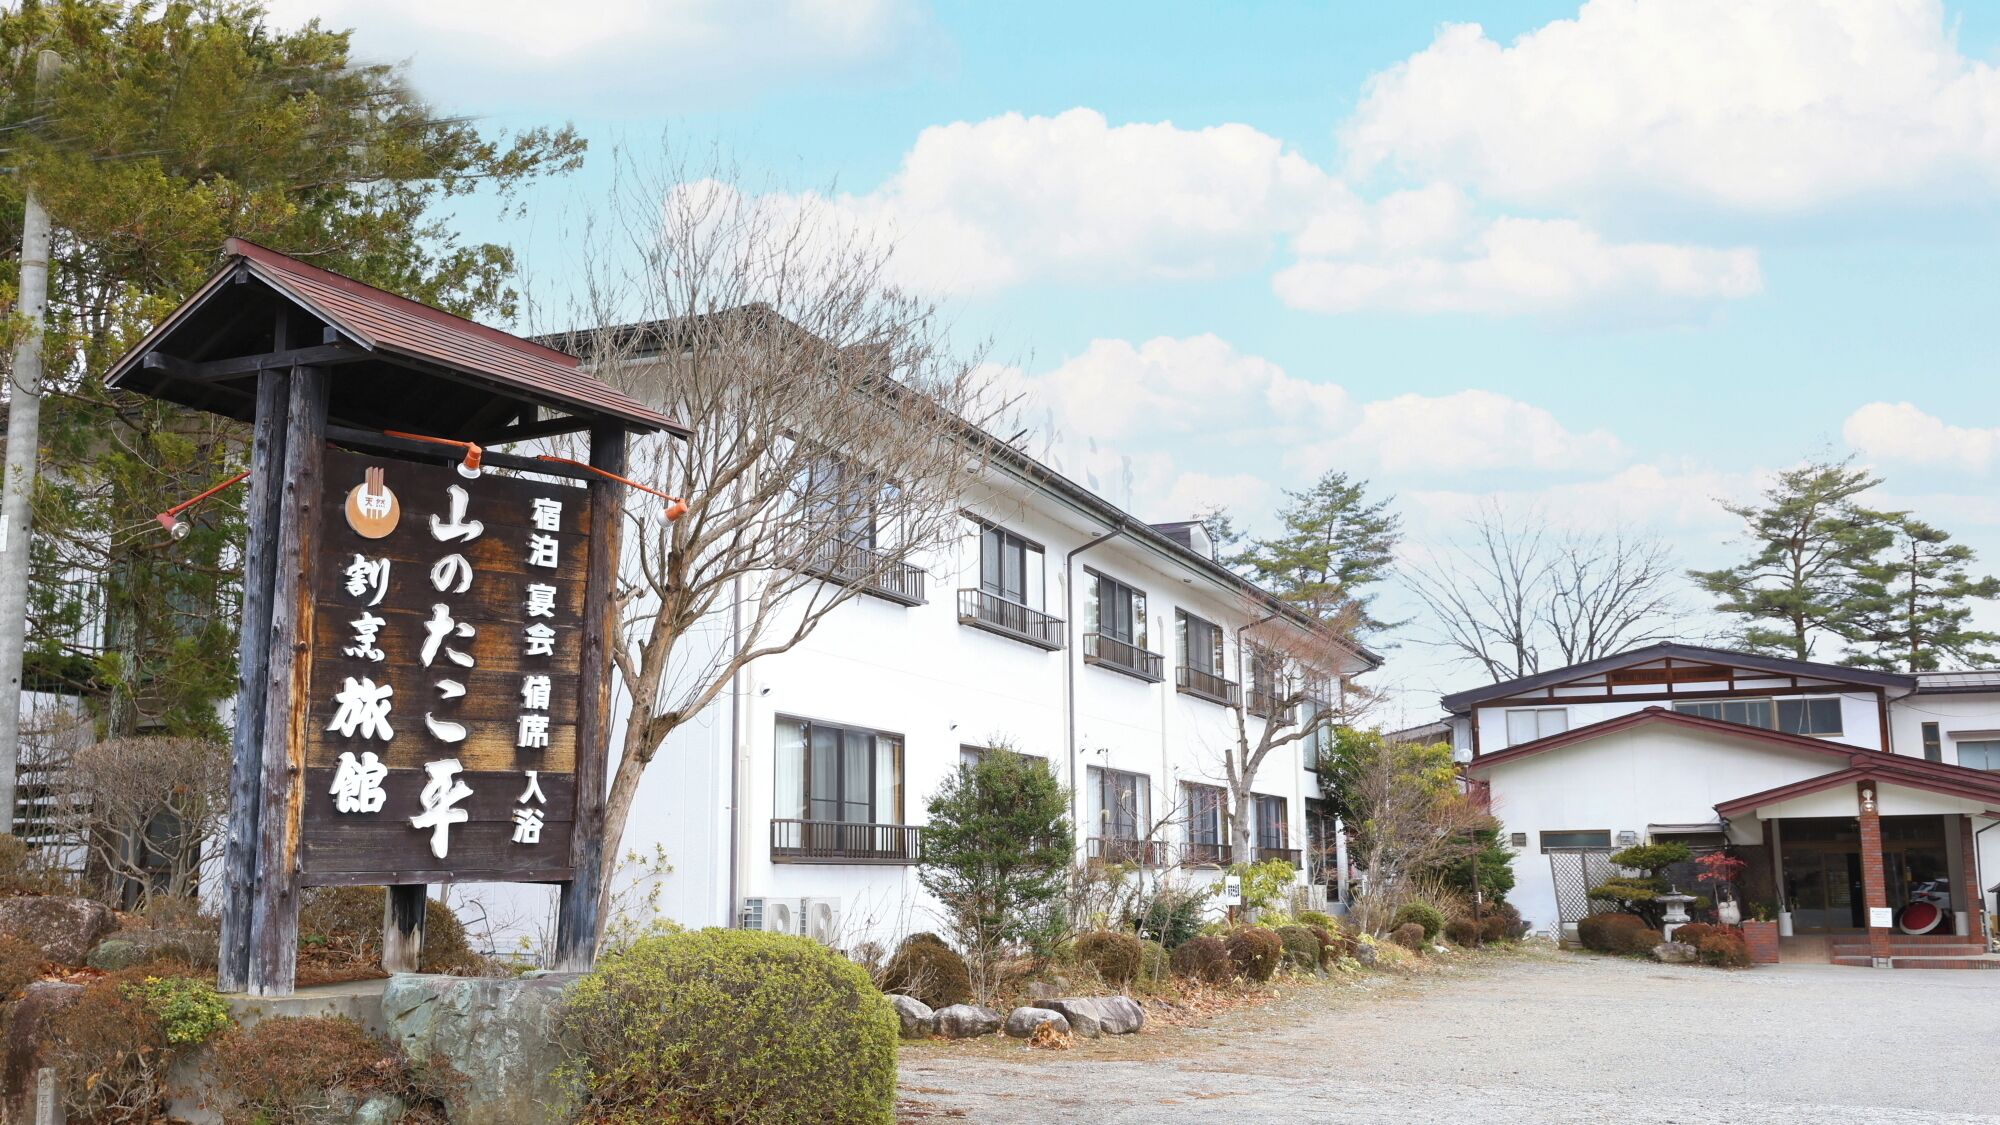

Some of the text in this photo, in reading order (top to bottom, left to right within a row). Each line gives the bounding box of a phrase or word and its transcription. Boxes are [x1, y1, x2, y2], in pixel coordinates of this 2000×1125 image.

[529, 498, 562, 568] 宿泊
[526, 583, 556, 656] 宴会
[410, 485, 484, 858] 山のたこ平
[512, 771, 546, 843] 入浴
